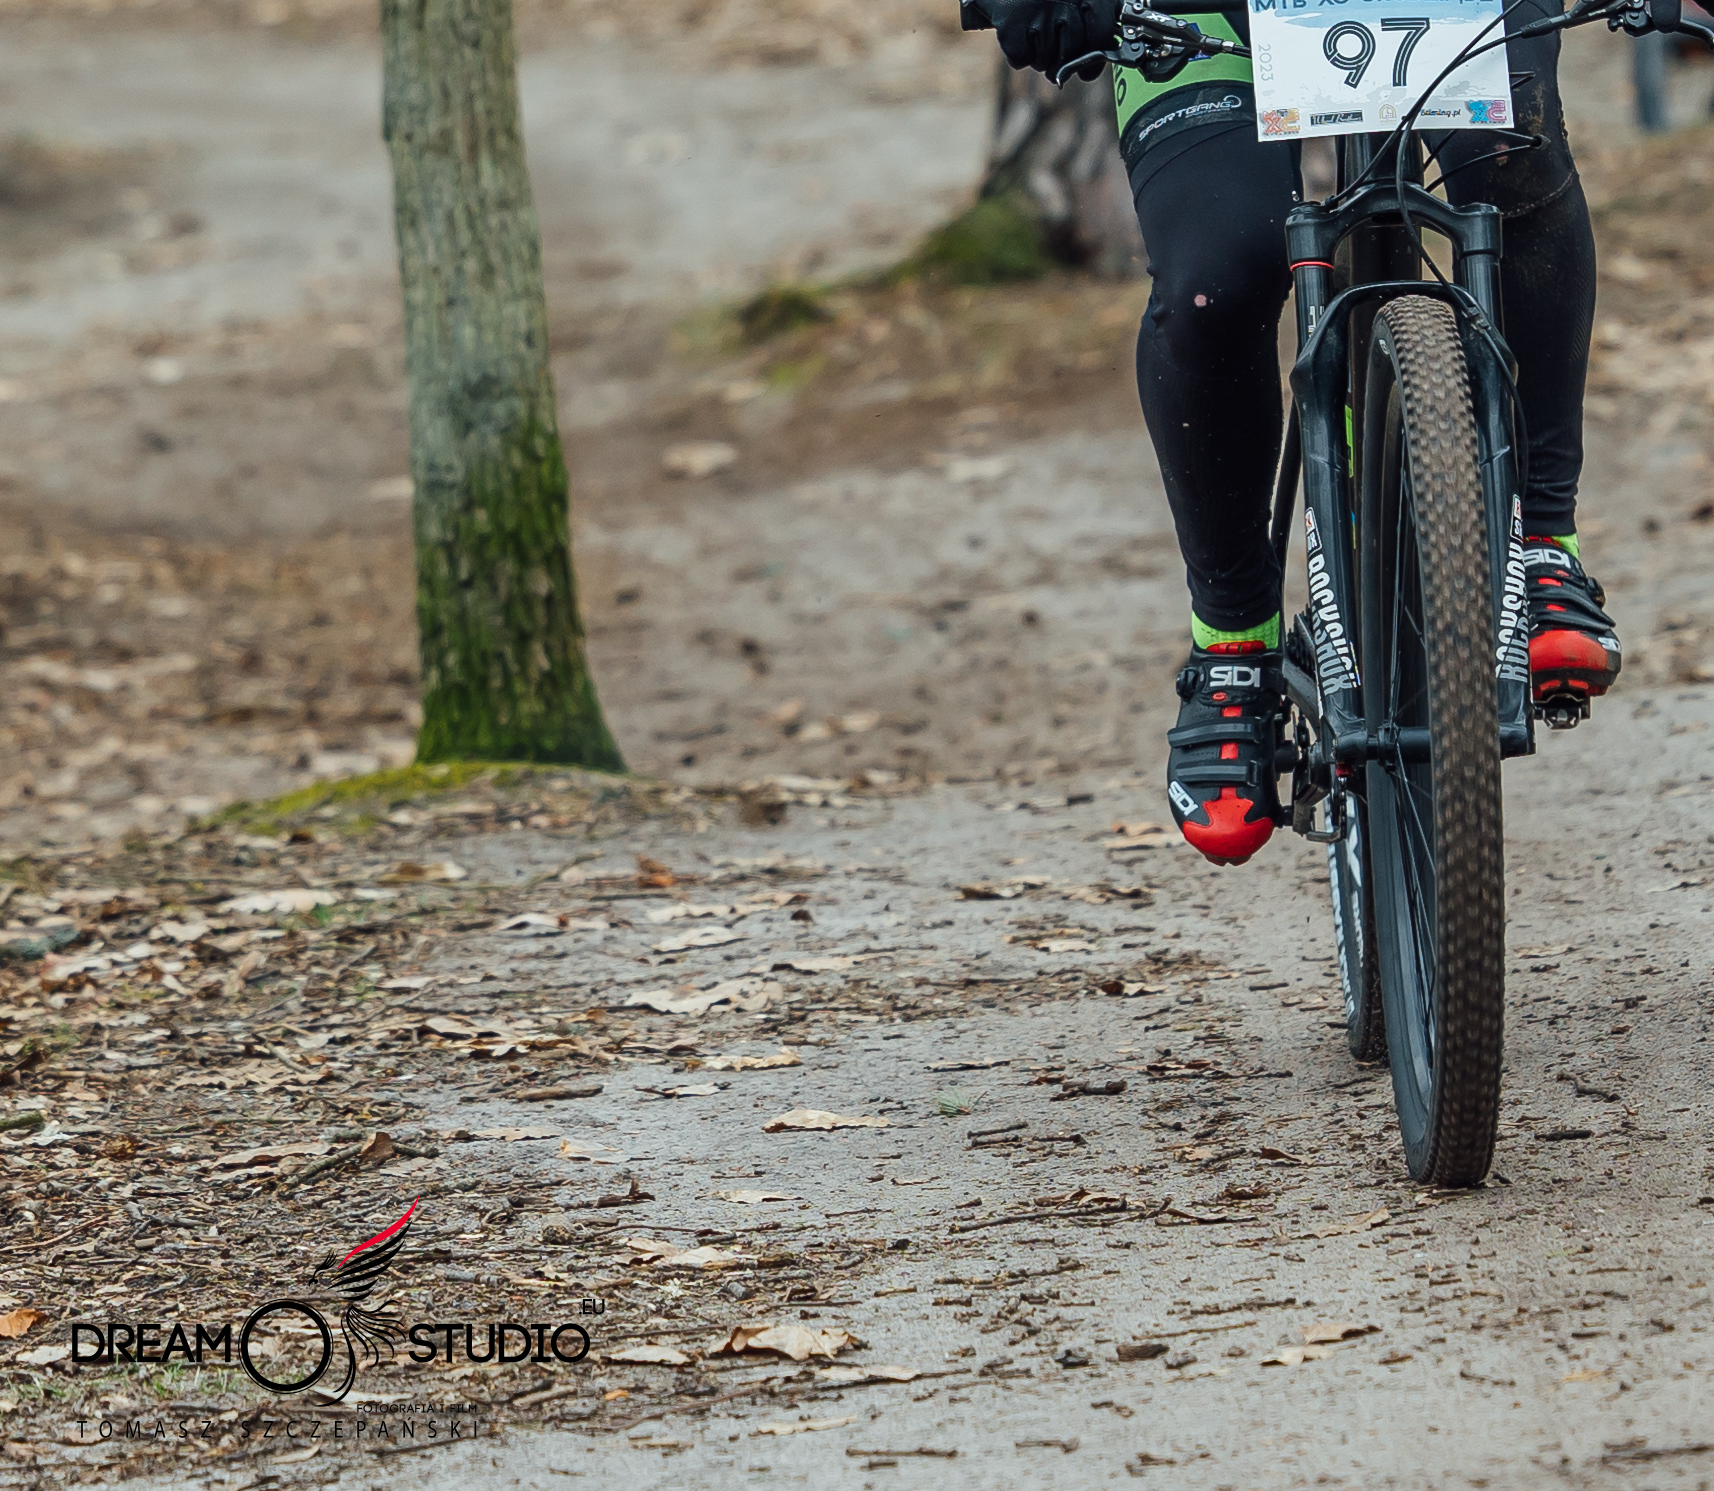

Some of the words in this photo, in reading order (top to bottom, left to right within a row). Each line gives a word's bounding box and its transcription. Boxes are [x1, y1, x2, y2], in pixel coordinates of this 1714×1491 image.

[1258, 44, 1274, 81] 2023
[1323, 17, 1431, 89] 97
[1139, 95, 1242, 141] SPORTGANG
[1523, 548, 1571, 569] SIDI
[1209, 665, 1261, 688] SIDI
[1168, 780, 1199, 817] SIDI
